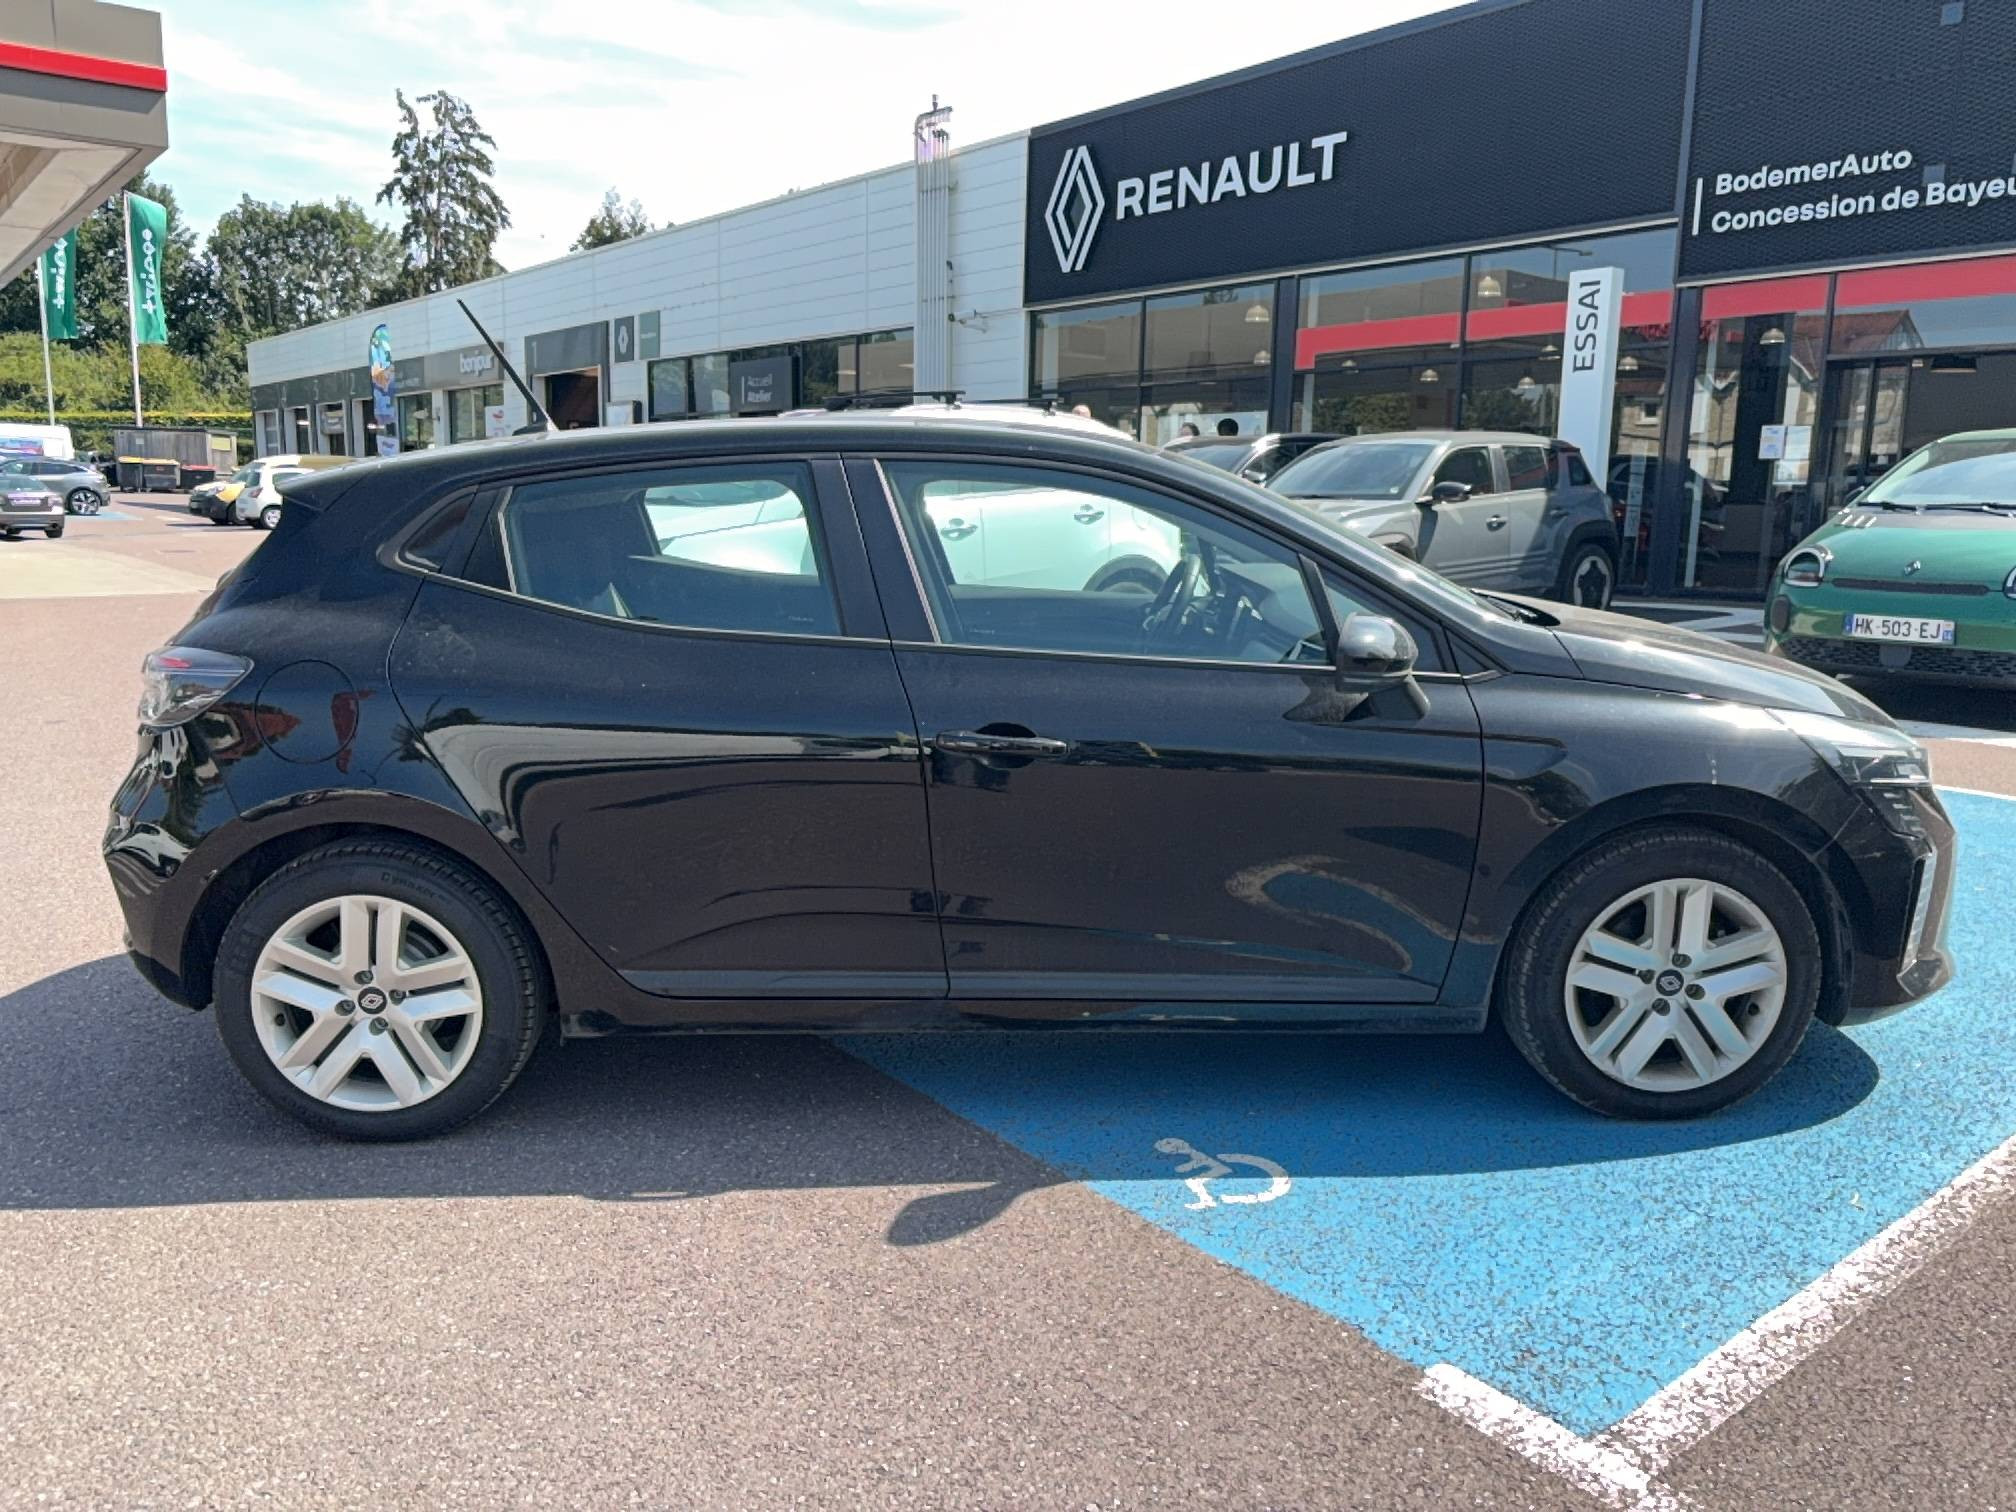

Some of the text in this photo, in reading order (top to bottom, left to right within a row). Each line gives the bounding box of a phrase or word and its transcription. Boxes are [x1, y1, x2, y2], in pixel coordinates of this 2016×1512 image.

[1116, 131, 1347, 220] RENAULT
[1715, 150, 1912, 195] BodemerAuto
[1711, 194, 1875, 233] Concession
[1881, 186, 1920, 211] de
[1572, 280, 1600, 373] ESSAI
